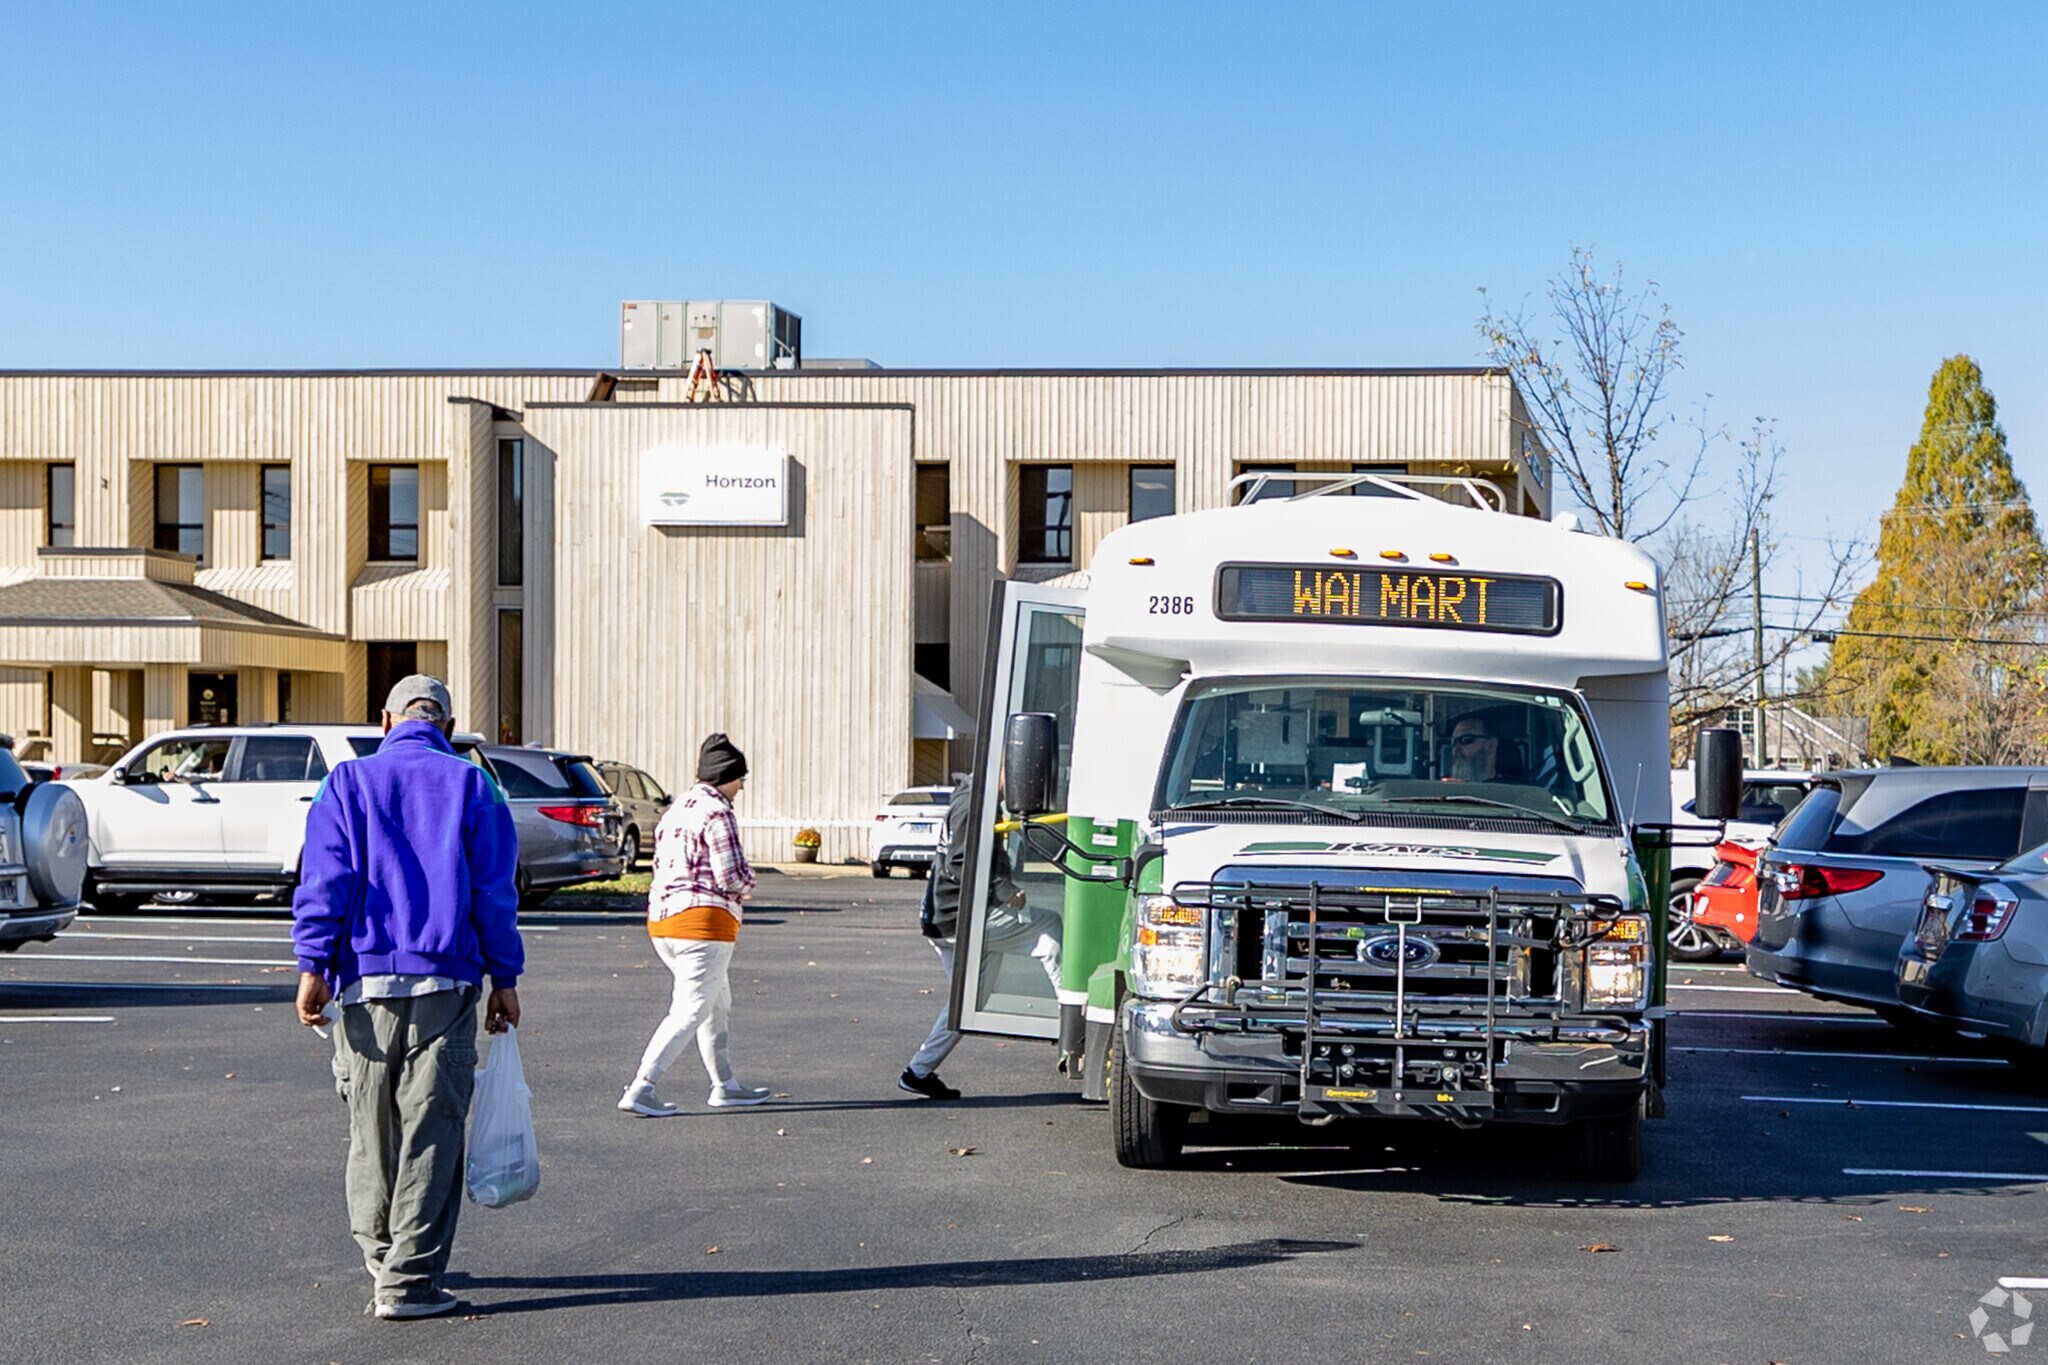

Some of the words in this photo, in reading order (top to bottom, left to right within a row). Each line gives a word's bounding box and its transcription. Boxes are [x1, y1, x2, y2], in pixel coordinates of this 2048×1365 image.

[1149, 595, 1194, 615] 2386
[1379, 573, 1498, 625] MART
[1381, 943, 1417, 959] Fod
